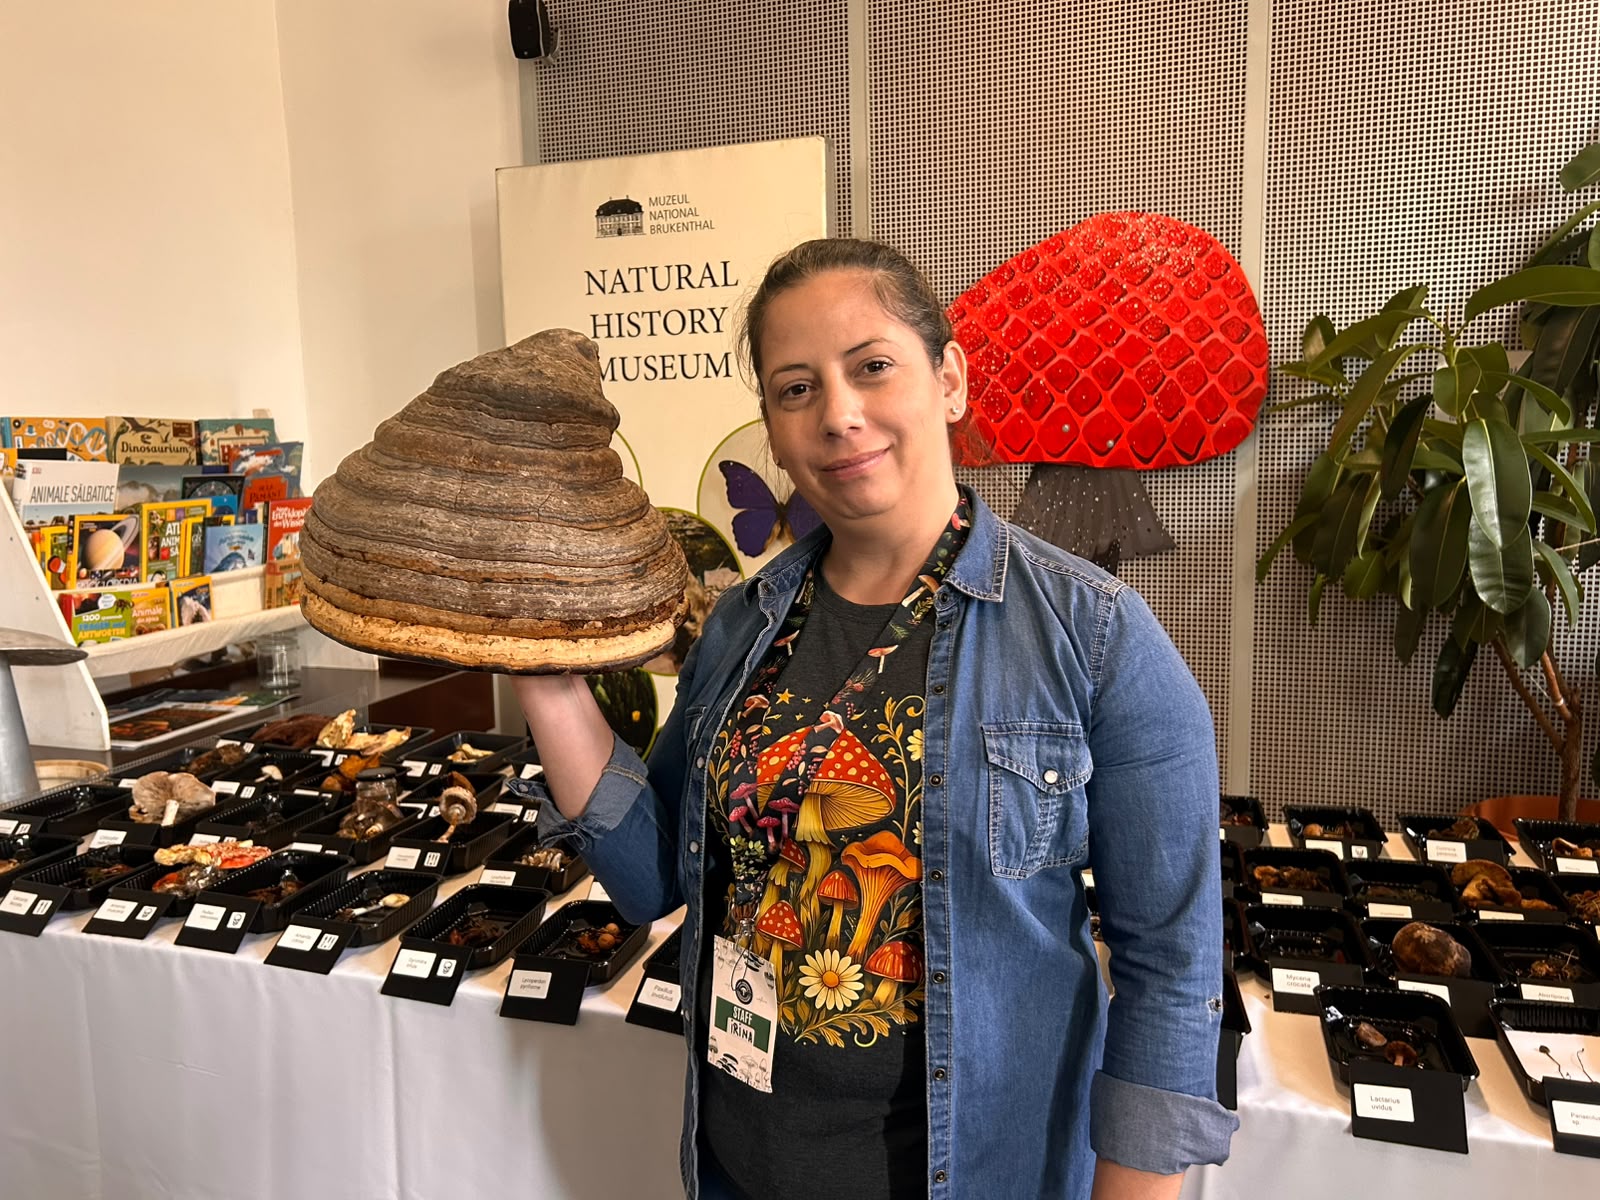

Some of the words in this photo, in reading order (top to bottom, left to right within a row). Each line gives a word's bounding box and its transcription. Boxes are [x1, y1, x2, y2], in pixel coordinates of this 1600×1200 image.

[648, 193, 690, 206] MUZEUL
[649, 206, 699, 222] NAȚIONAL
[649, 219, 715, 235] BRUKENTHAL
[584, 260, 739, 296] NATURAL
[590, 306, 728, 339] HISTORY
[121, 441, 189, 453] Dinosaurium
[29, 485, 70, 504] ANIMALE
[71, 483, 115, 502] SĂLBATICE
[272, 508, 306, 521] Enzyklop
[165, 522, 180, 536] ATL
[160, 537, 180, 548] ANIM
[82, 613, 100, 622] 1200
[132, 607, 163, 618] Animale
[1285, 974, 1311, 982] Mycena
[732, 1005, 753, 1026] STAFF
[1370, 1095, 1401, 1104] Lactarius
